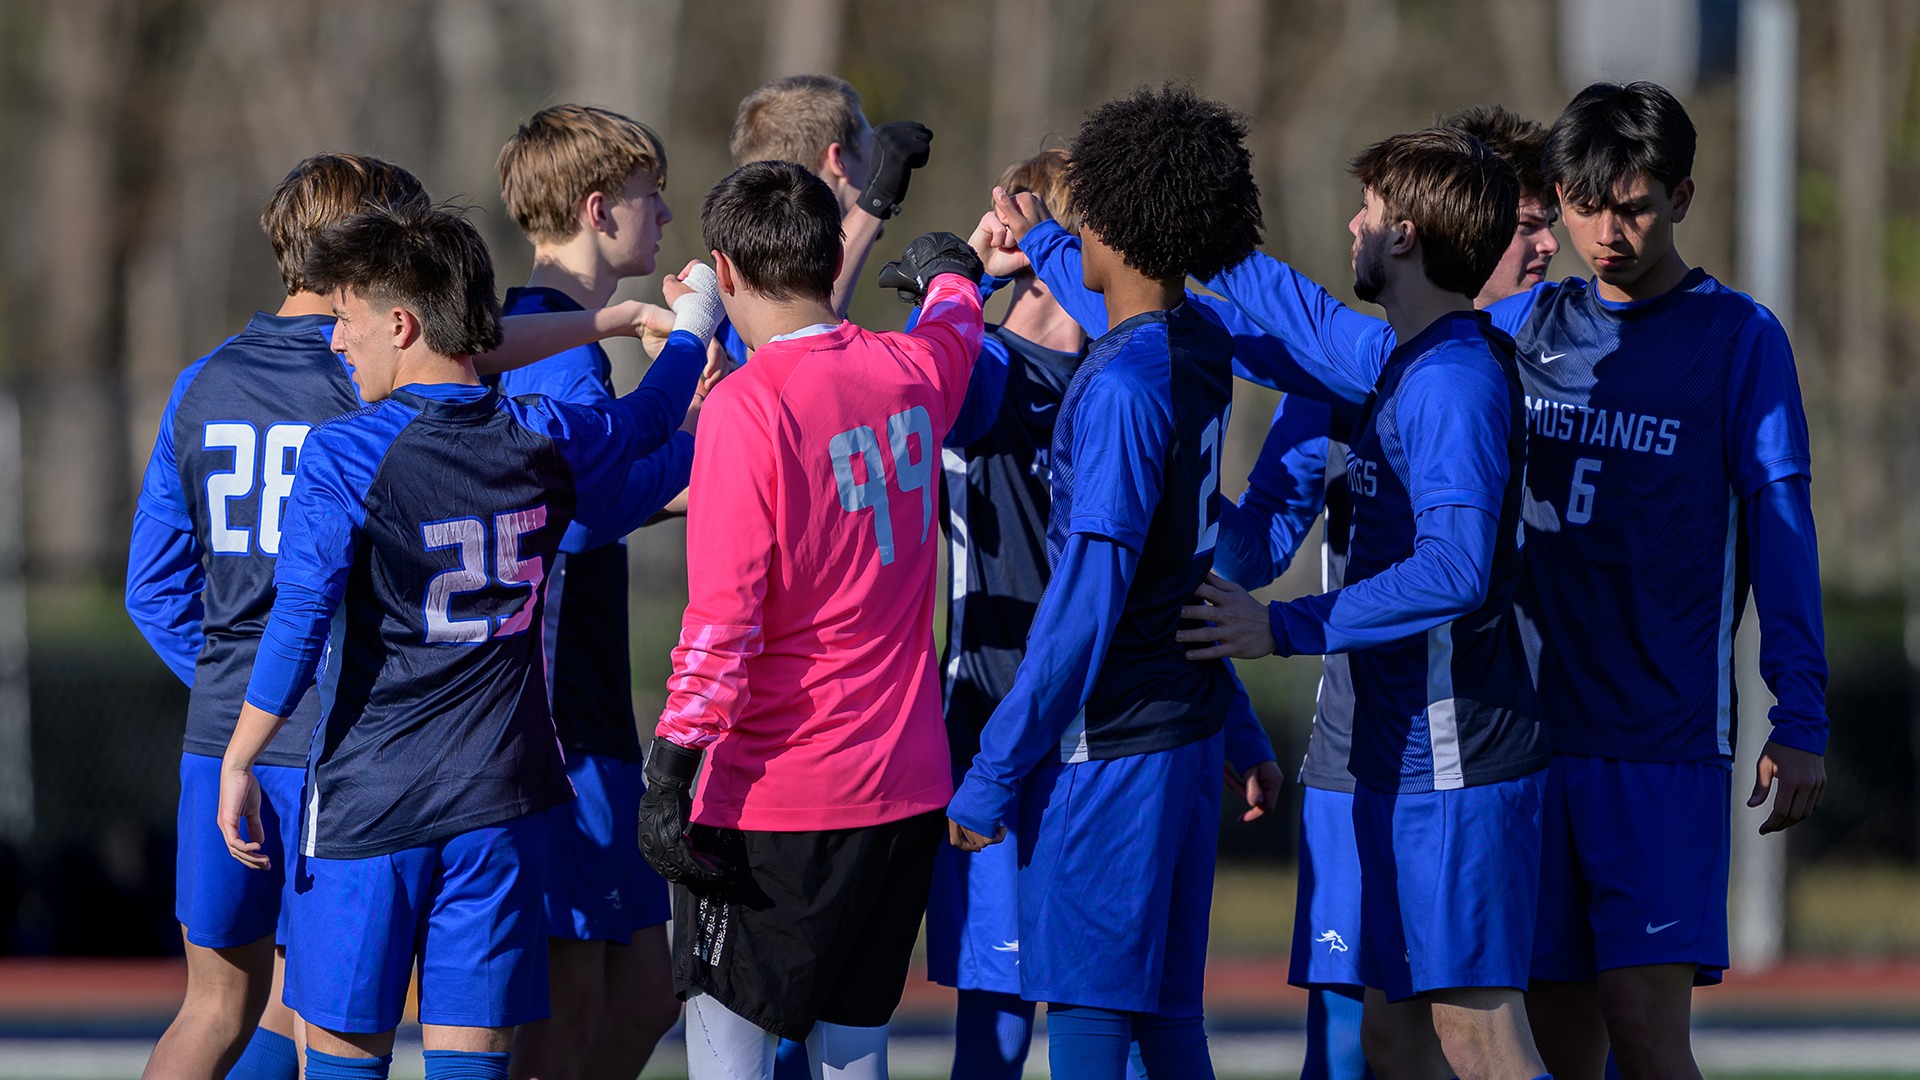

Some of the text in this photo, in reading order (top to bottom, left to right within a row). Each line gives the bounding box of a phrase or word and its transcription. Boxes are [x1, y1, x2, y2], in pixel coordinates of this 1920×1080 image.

[202, 420, 314, 557] 28
[829, 405, 934, 566] 99
[1194, 402, 1232, 556] 2
[1524, 395, 1681, 456] MUSTANGS
[1566, 457, 1602, 525] 6
[421, 505, 548, 645] 25
